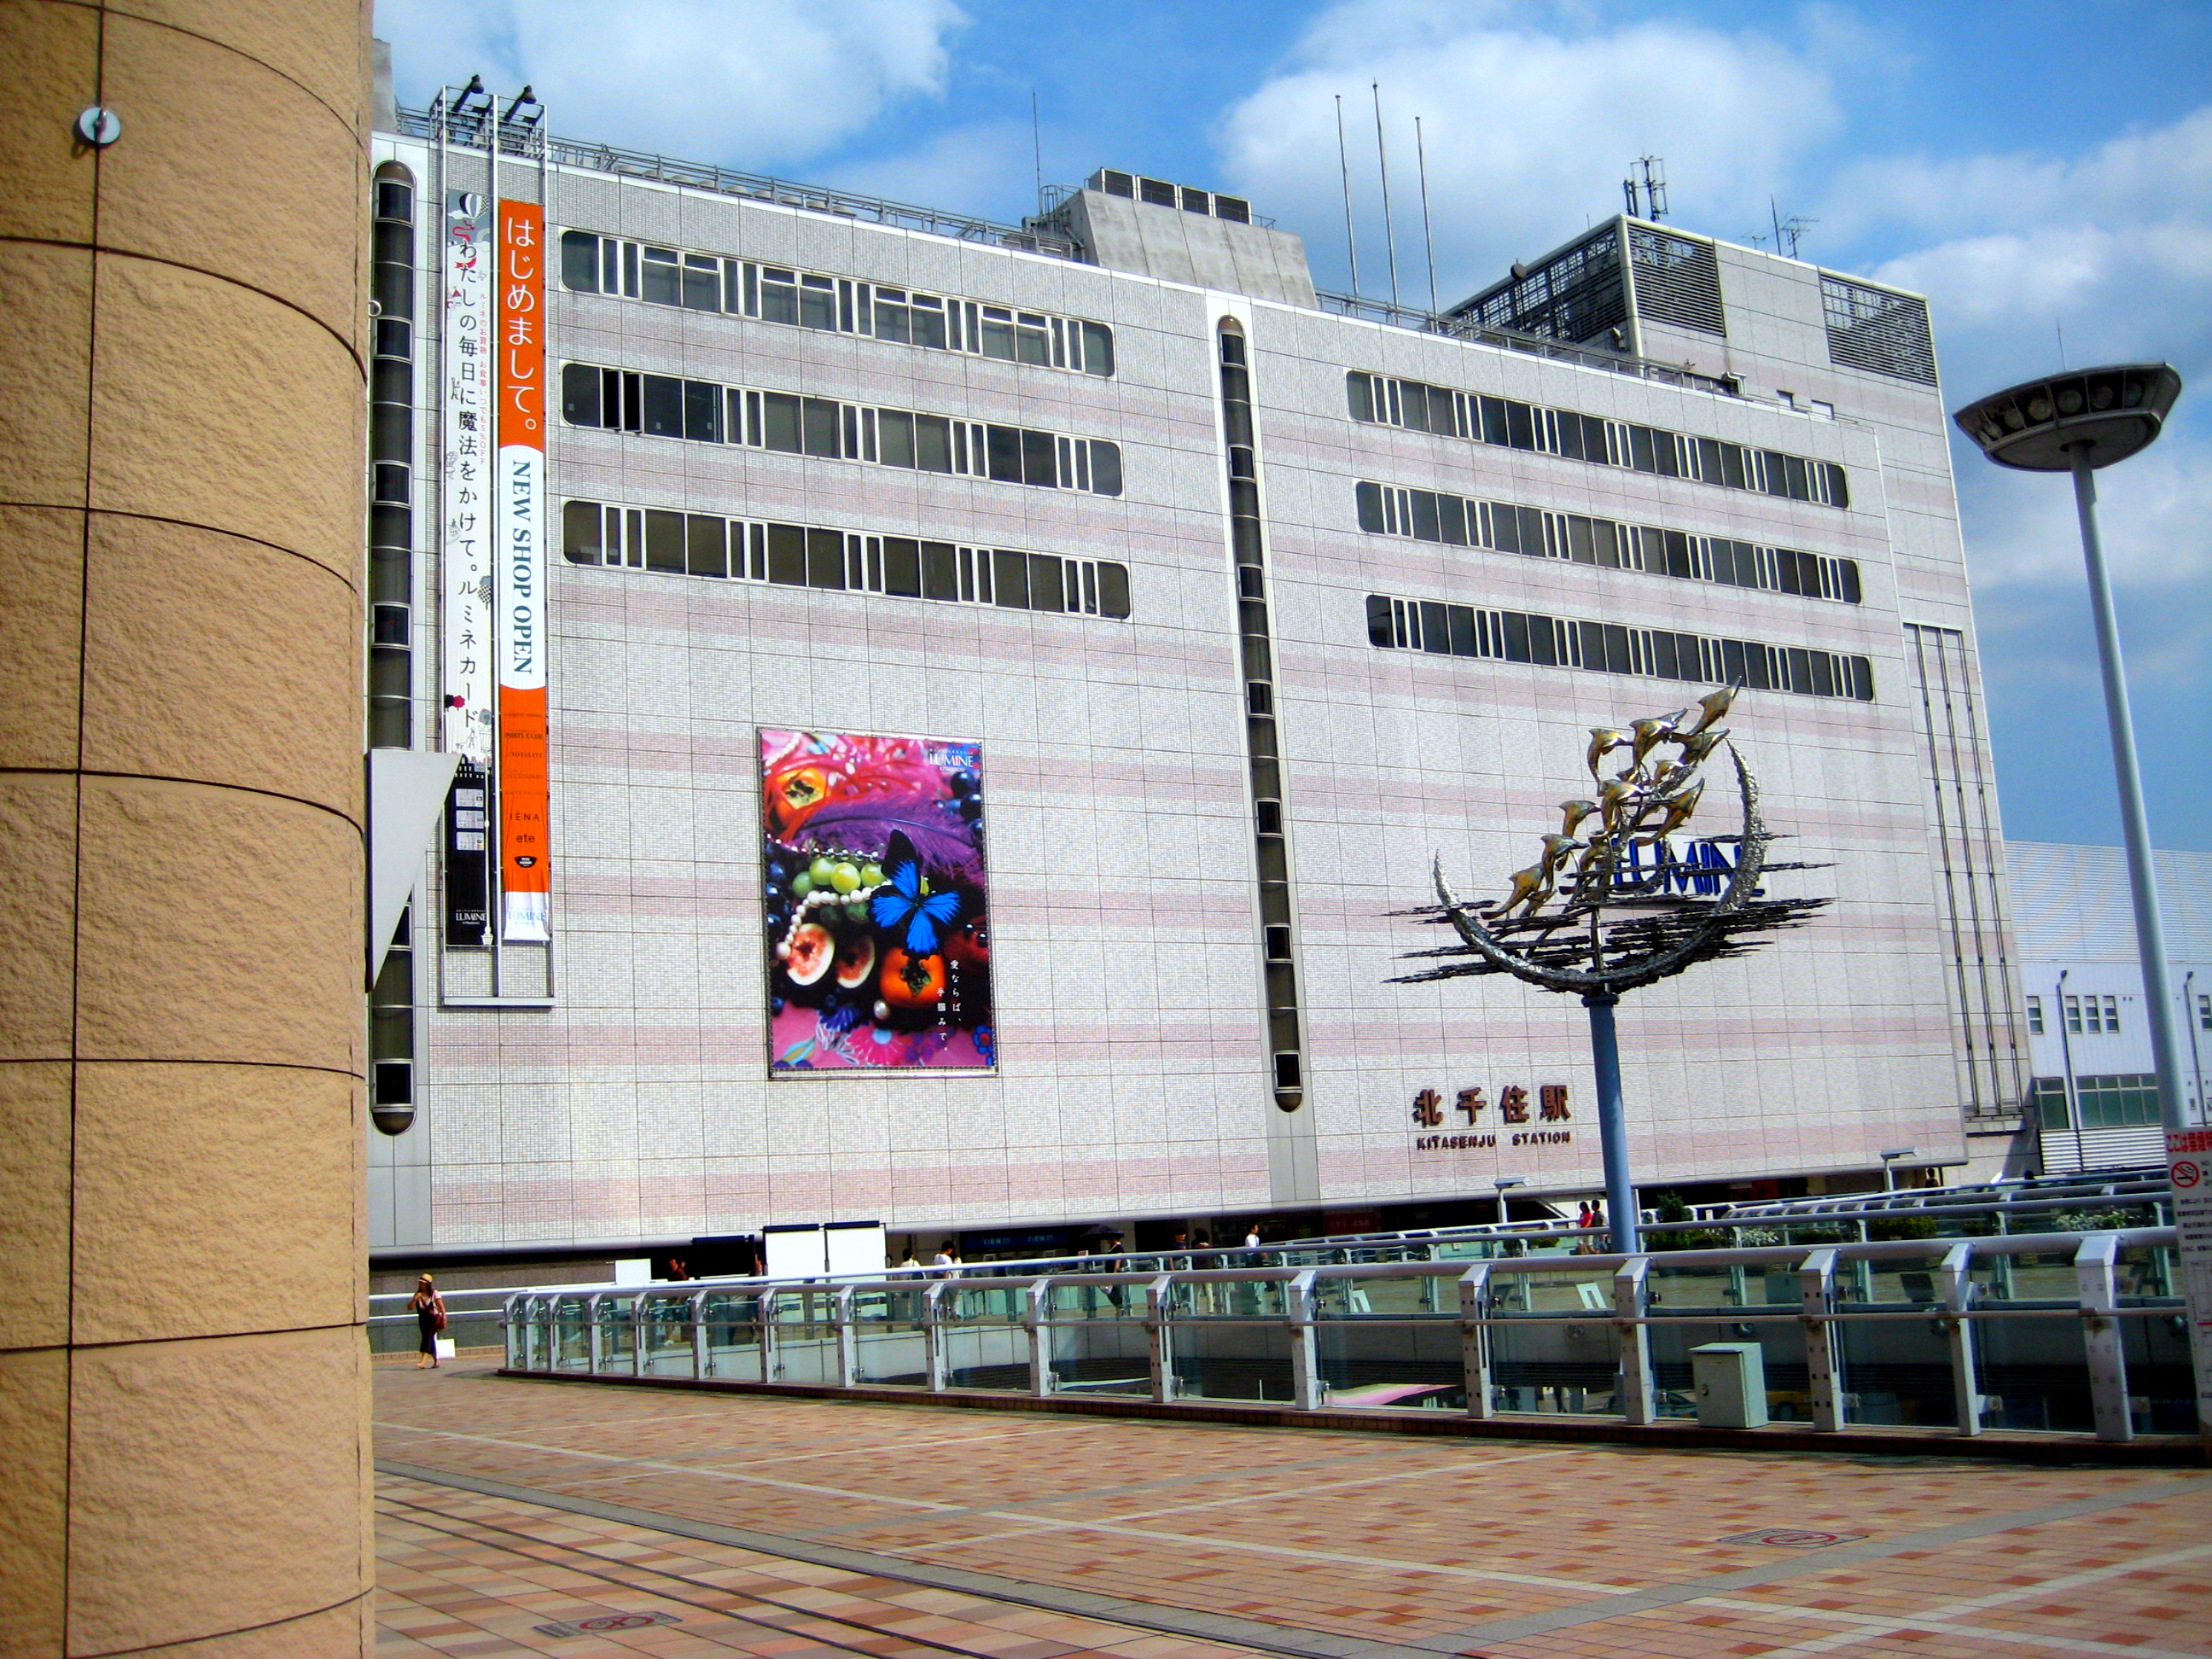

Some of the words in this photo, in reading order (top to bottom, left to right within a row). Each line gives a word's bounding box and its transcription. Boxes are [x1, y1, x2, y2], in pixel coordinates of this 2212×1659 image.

[506, 218, 537, 431] はじめまして。
[512, 460, 533, 523] NEW
[512, 528, 533, 598] SHOP
[513, 605, 533, 676] OPEN
[929, 754, 974, 767] LUMINE
[456, 912, 486, 921] LUMINE
[508, 911, 546, 922] LUMINE
[950, 959, 962, 1022] 愛ならば、
[1412, 1085, 1572, 1128] 北千住駅
[1417, 1134, 1496, 1150] KITASENJU
[1511, 1131, 1571, 1146] STATION
